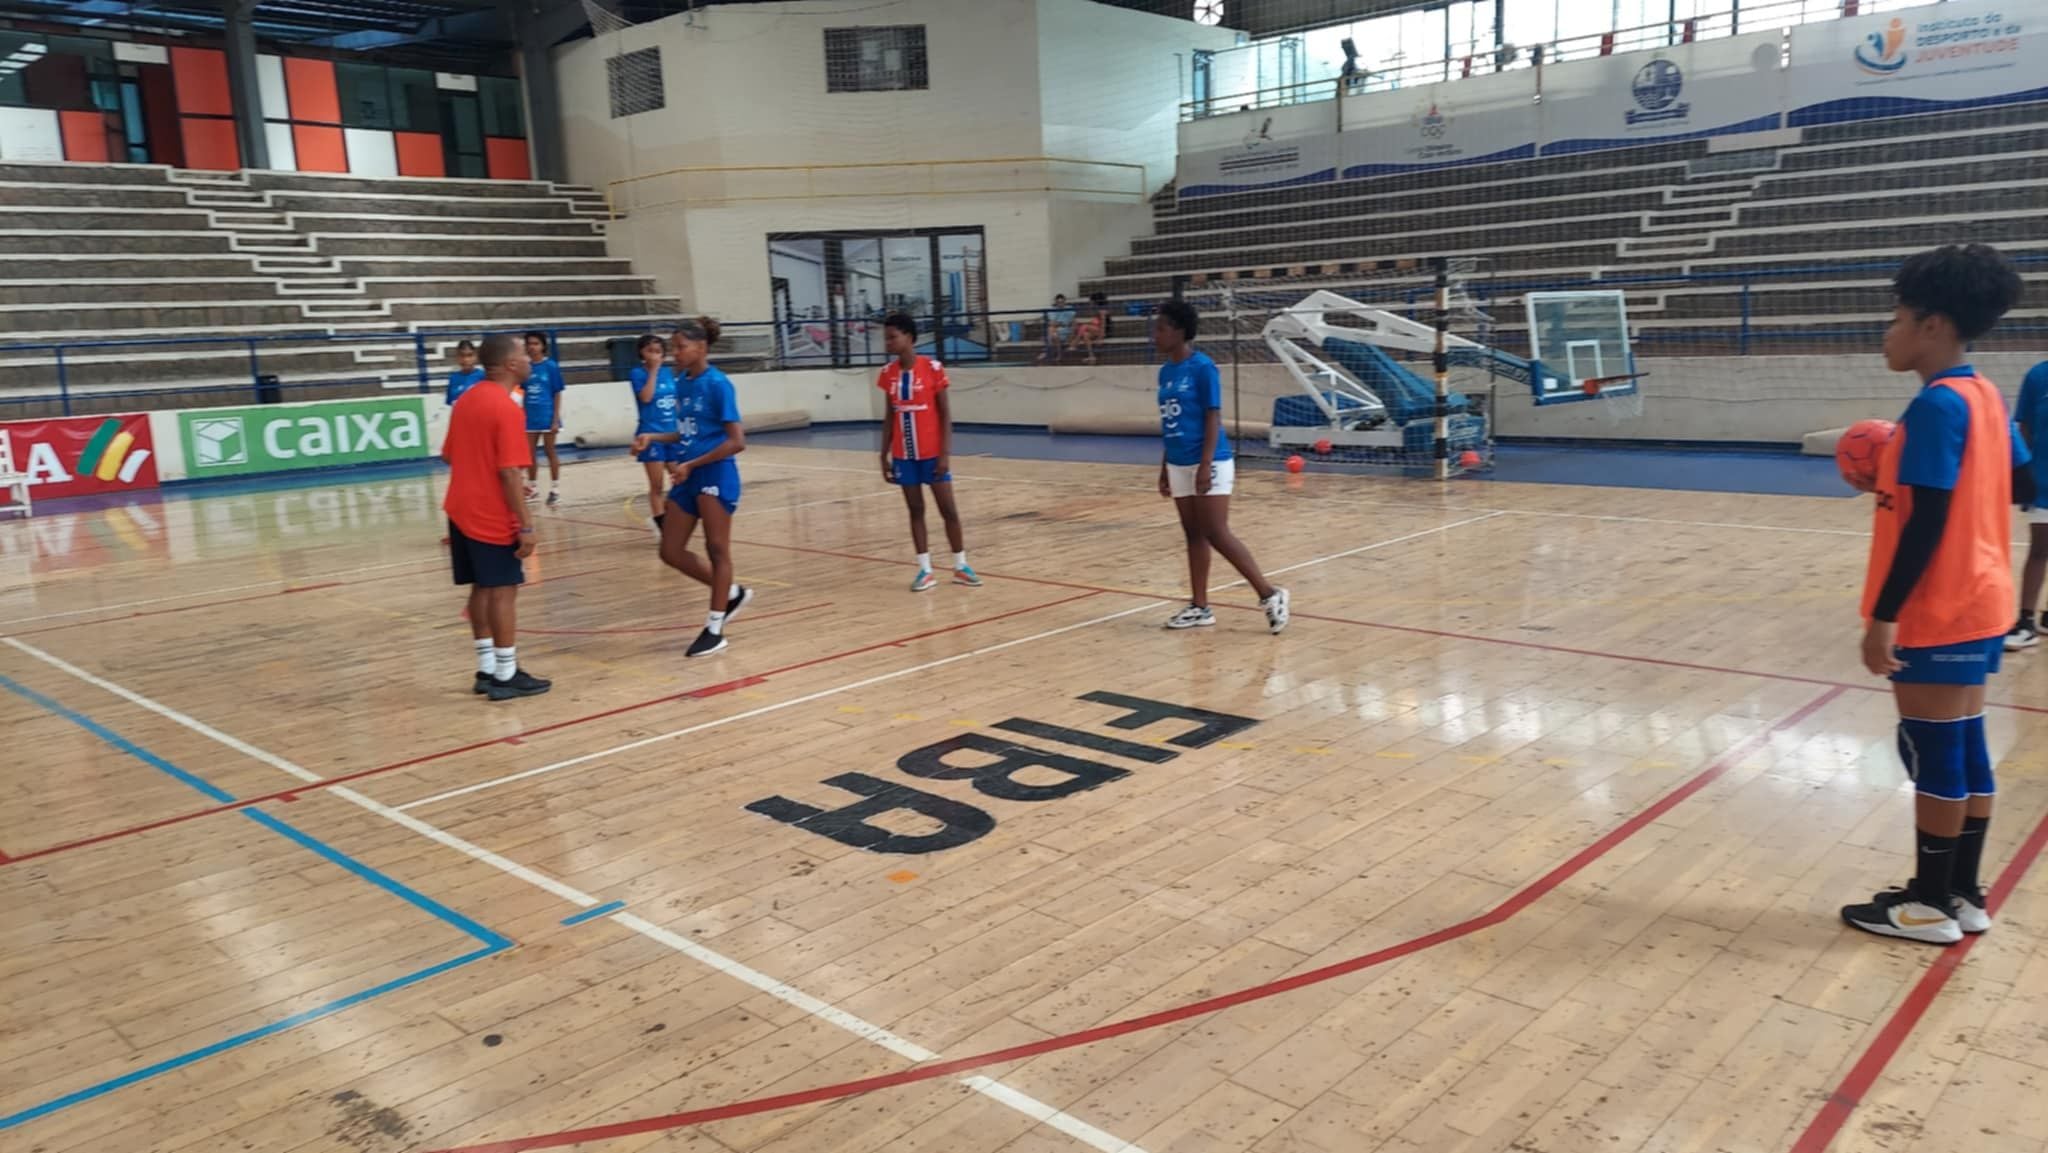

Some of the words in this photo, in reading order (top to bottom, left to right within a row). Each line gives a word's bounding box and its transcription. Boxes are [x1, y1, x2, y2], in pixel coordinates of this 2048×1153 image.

[1914, 37, 2020, 63] JUVENTUDE
[263, 410, 422, 459] caixa
[743, 690, 1262, 856] FIBA
